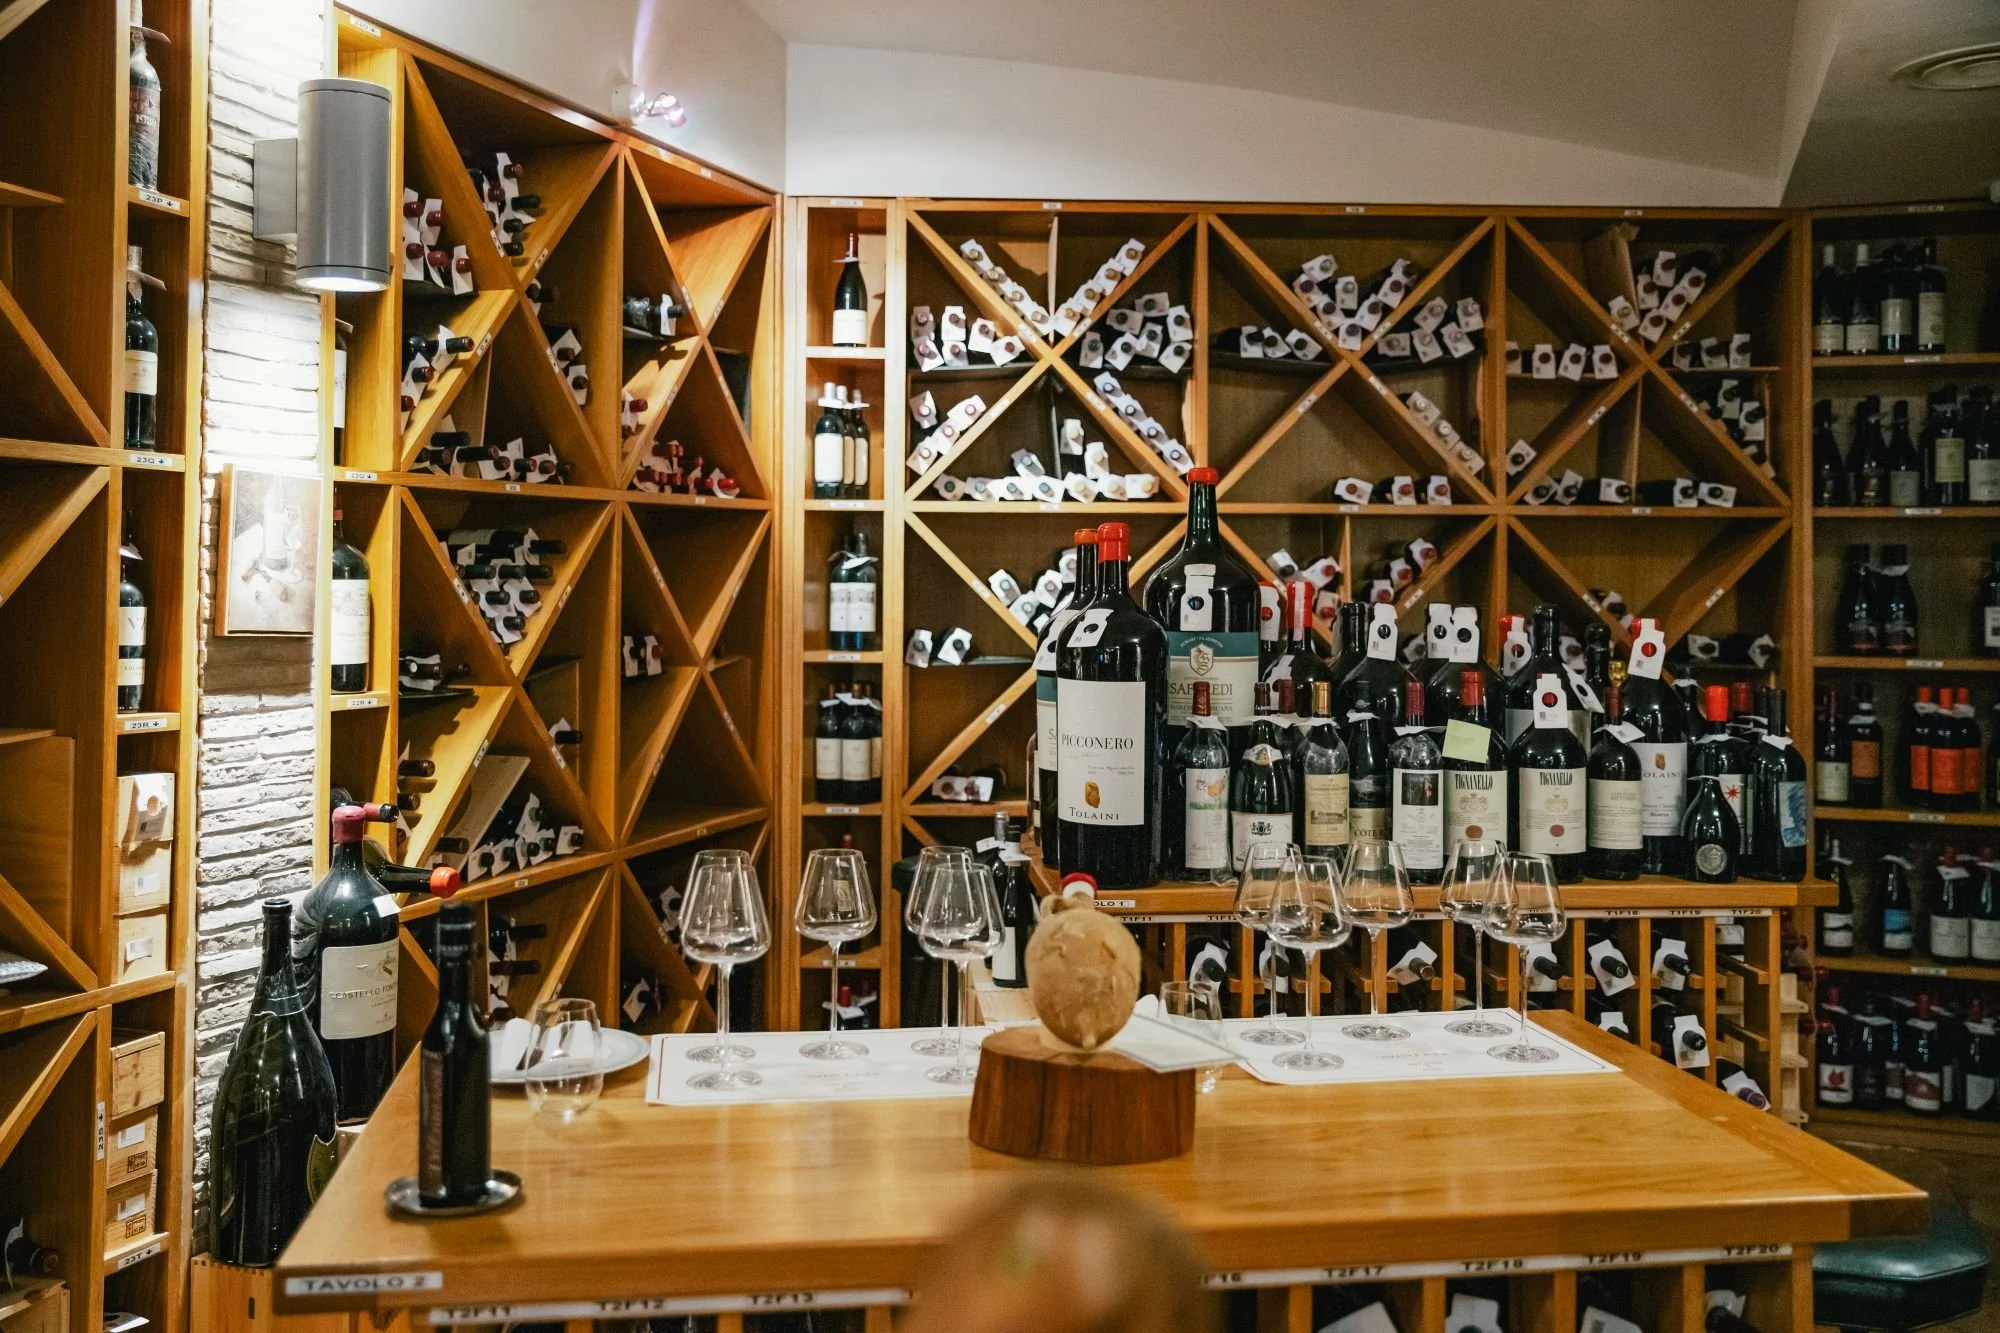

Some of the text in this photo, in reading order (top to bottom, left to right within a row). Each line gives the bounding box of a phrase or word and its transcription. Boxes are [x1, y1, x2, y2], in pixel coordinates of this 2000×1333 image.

[1169, 683, 1233, 696] SAFEDI
[1061, 733, 1134, 750] PICCONERO
[1455, 773, 1494, 790] TIGNANELLO
[1539, 771, 1573, 786] TIGNANELLO
[1069, 806, 1119, 821] TOLAINI
[1725, 1244, 1779, 1256] T2F20
[1463, 1259, 1523, 1272] T2F18
[1588, 1252, 1642, 1264] T2F19
[1325, 1265, 1384, 1278] T2F17
[304, 1275, 426, 1293] TAVOLO 2
[600, 1297, 665, 1312] T2F12
[752, 1292, 814, 1305] T2F13
[448, 1304, 512, 1320] T2F11
